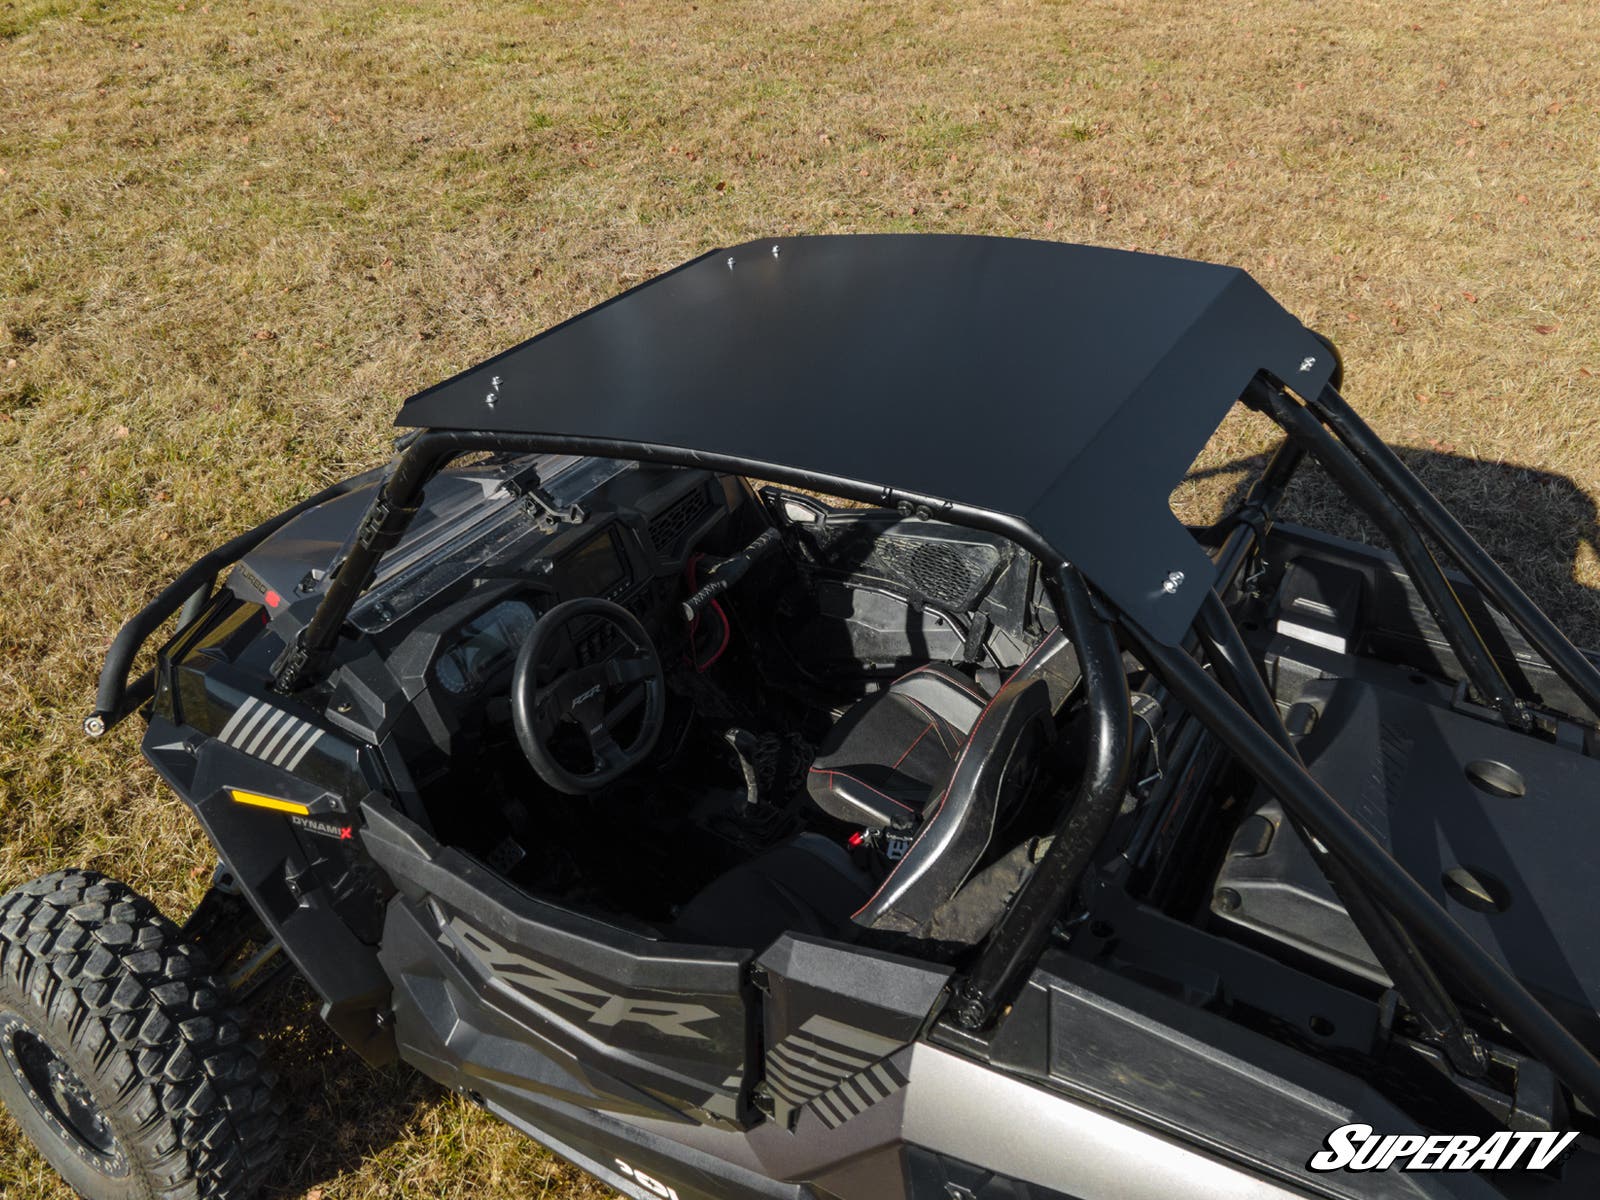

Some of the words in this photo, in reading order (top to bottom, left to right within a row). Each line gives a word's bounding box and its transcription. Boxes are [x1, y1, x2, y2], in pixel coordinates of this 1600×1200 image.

[239, 563, 267, 595] TURBO
[291, 815, 353, 839] DYNAMIX
[437, 916, 720, 1040] RZR
